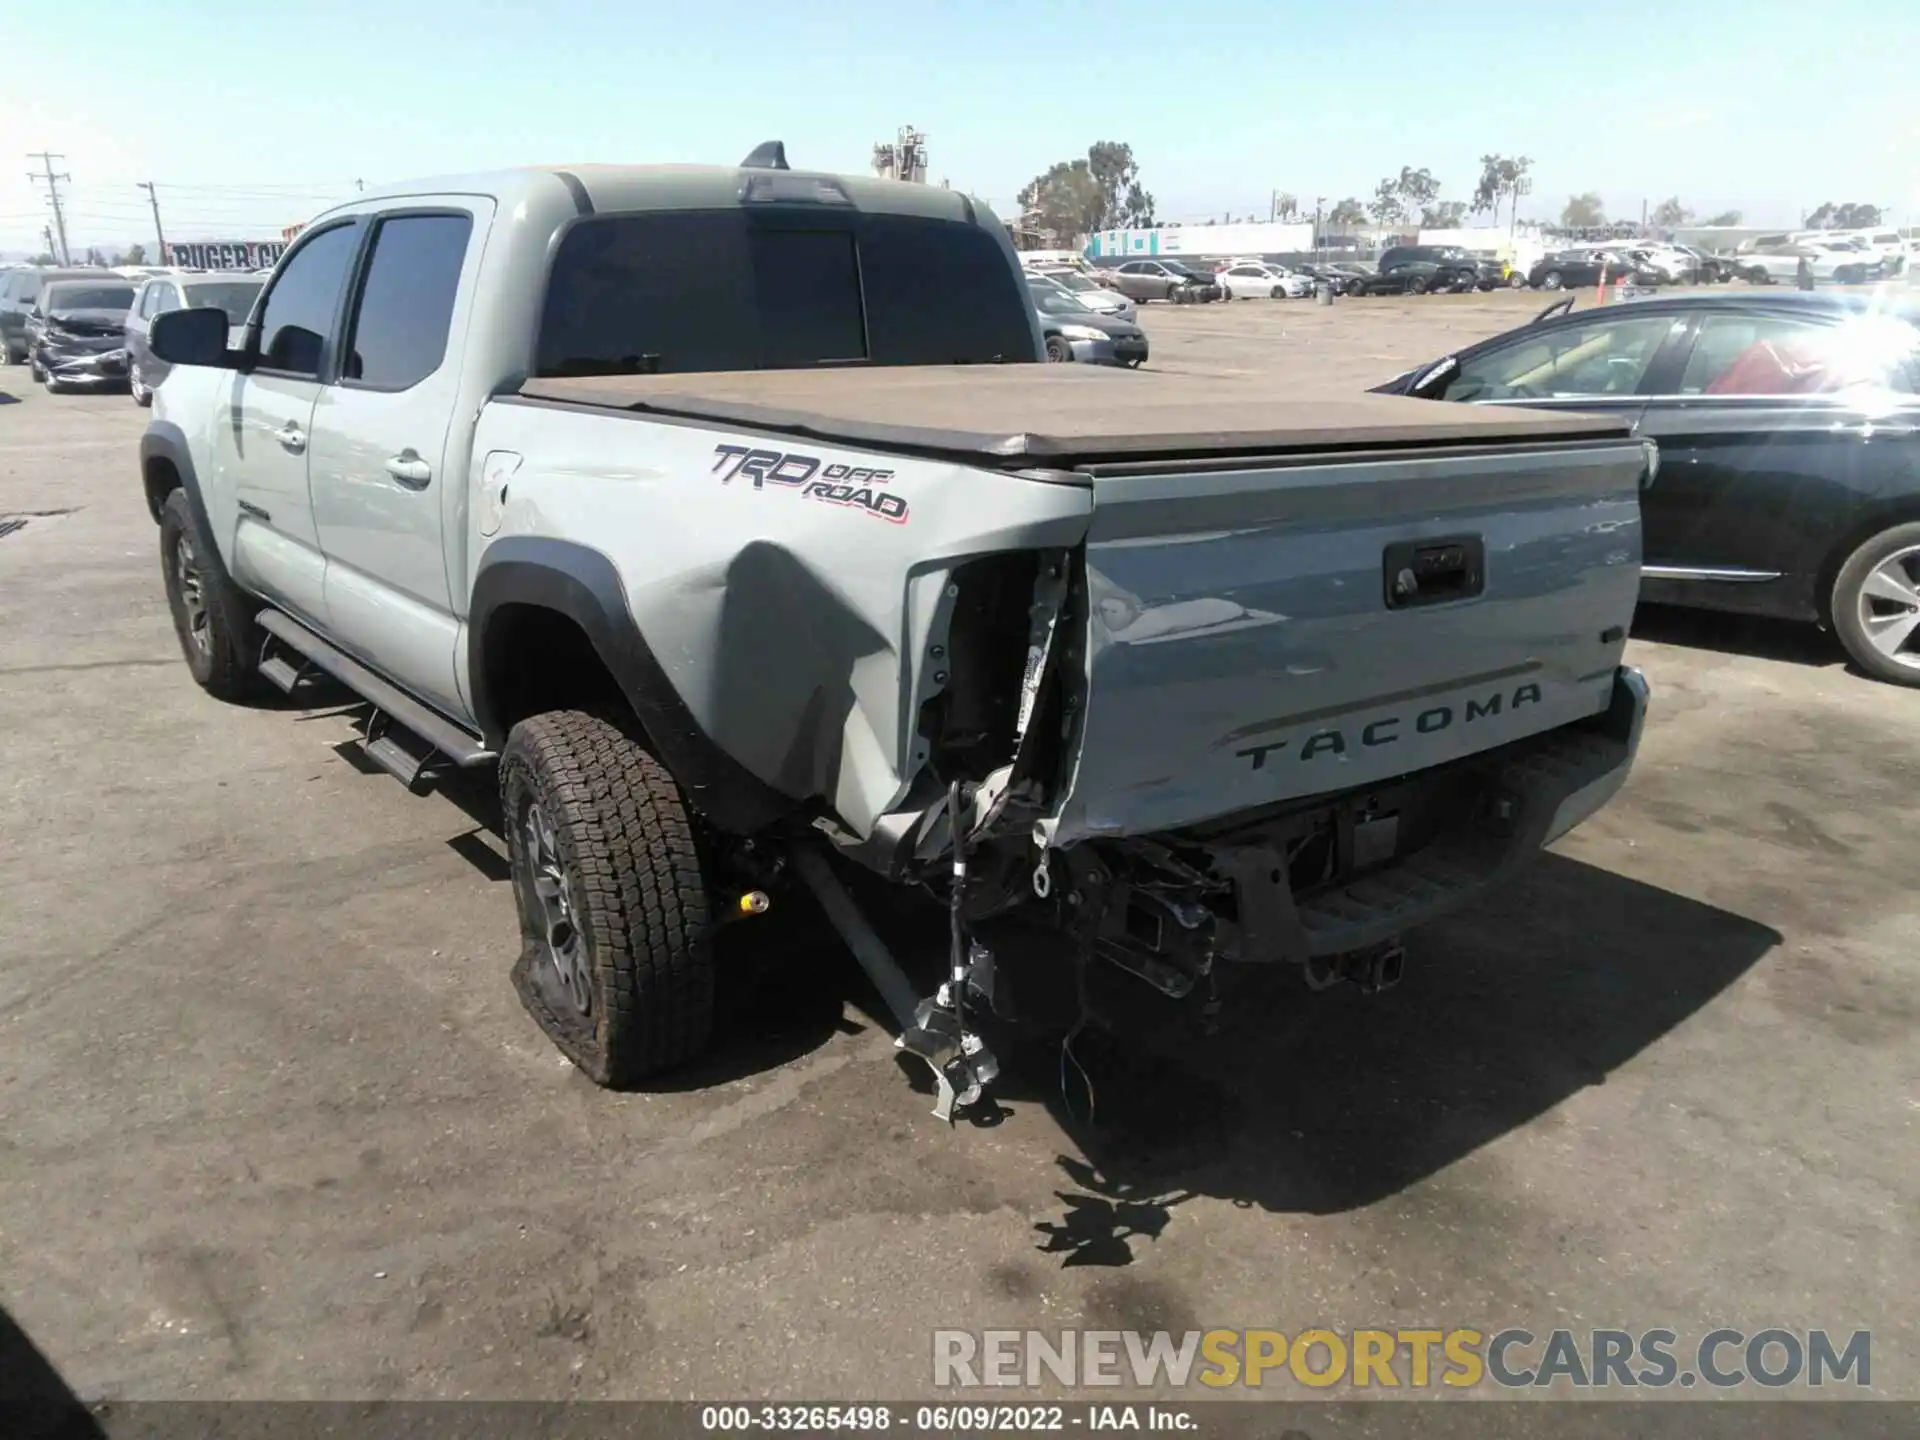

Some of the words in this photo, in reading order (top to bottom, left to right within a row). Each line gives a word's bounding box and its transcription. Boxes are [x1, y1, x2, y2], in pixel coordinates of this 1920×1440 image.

[712, 444, 821, 490] TRD
[822, 463, 895, 485] OFF
[802, 481, 909, 525] ROAD
[1236, 683, 1542, 771] TACOMA
